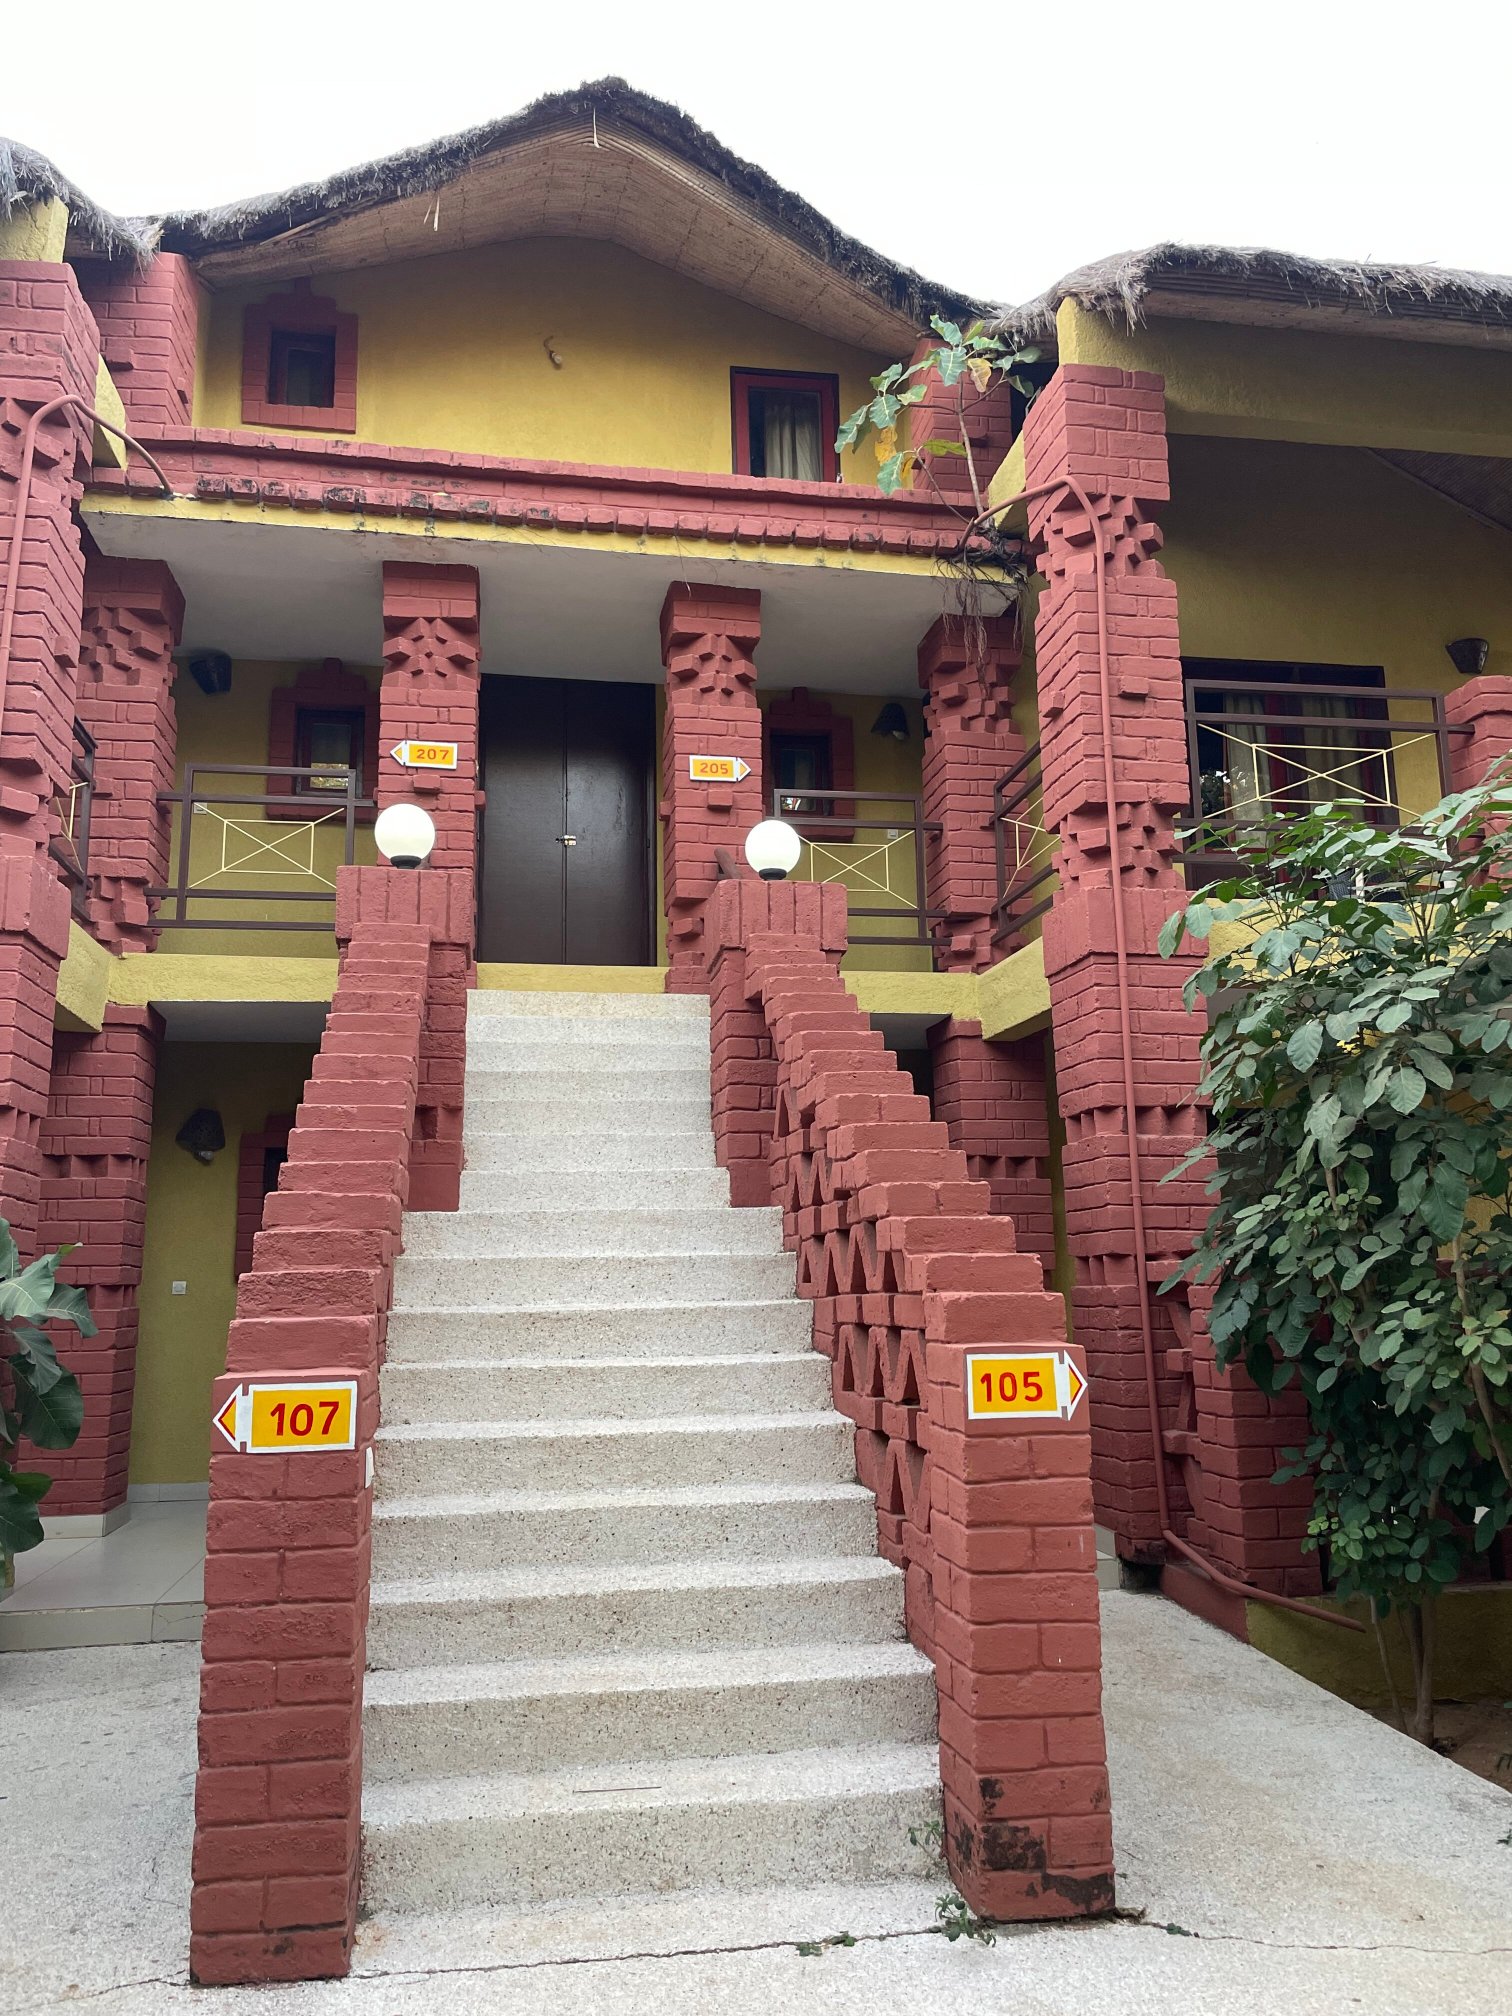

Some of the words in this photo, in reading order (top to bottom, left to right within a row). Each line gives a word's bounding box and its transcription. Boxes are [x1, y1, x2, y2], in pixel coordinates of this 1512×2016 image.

[416, 748, 450, 760] 207
[700, 762, 729, 775] 205
[980, 1371, 1043, 1403] 105
[270, 1401, 340, 1436] 107
